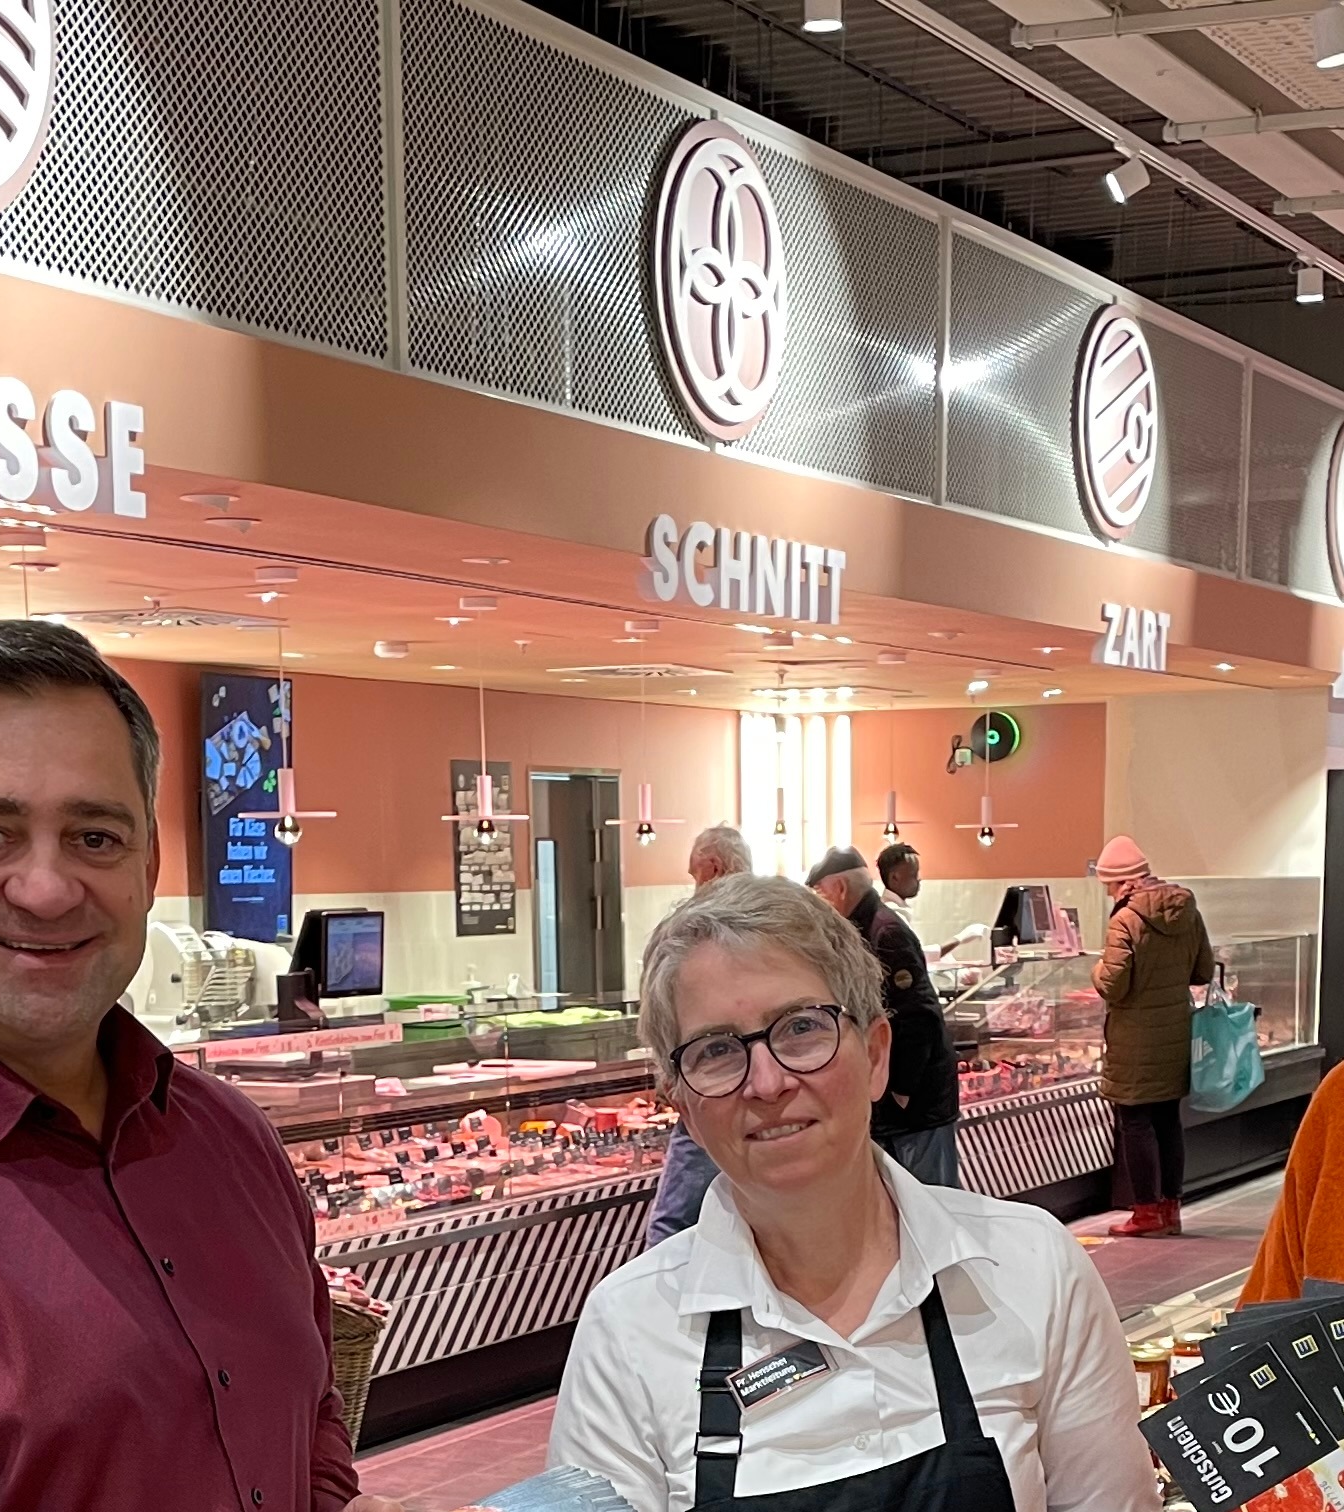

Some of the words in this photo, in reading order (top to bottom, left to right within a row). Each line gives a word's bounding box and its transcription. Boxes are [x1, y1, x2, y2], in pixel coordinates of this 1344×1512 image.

[646, 513, 846, 625] SCHNITT
[1102, 602, 1171, 672] ZART
[1167, 1415, 1233, 1504] Gutschein
